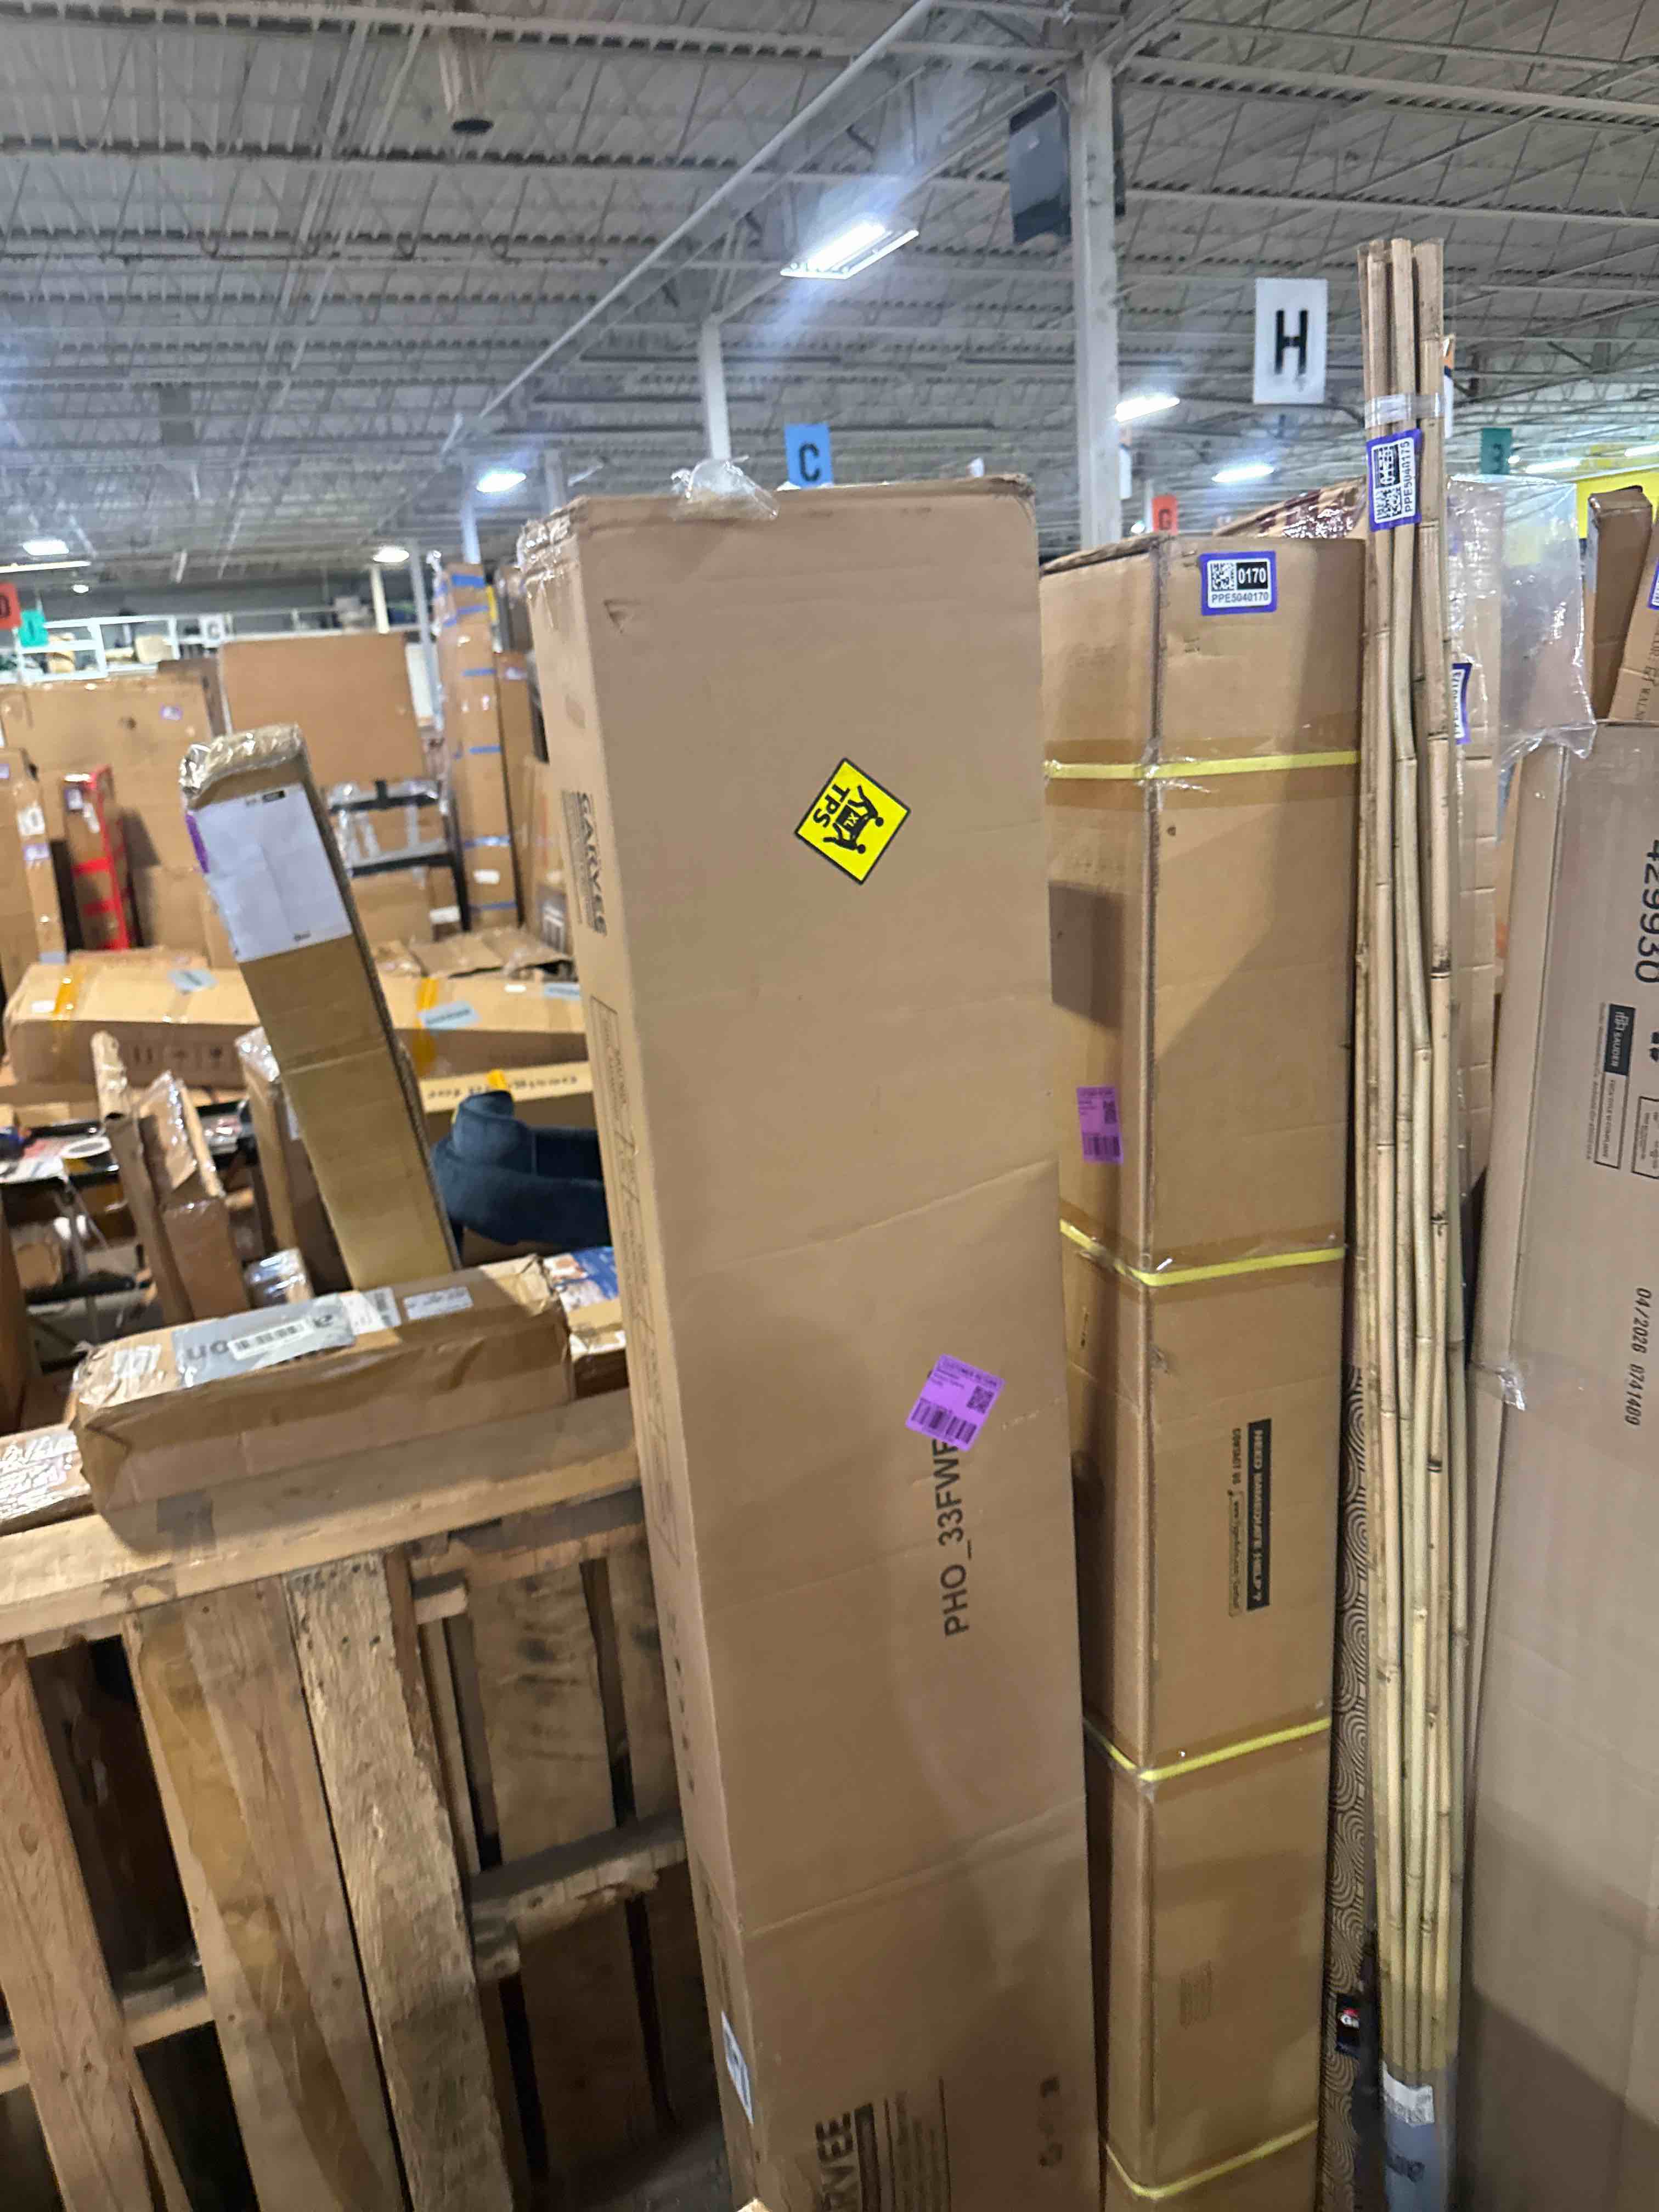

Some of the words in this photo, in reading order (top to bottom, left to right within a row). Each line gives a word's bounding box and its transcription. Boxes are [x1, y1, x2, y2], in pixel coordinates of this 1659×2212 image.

[1275, 309, 1308, 376] H
[798, 442, 821, 483] C
[1238, 567, 1267, 585] 0170
[1211, 591, 1269, 604] PPE5040170
[813, 783, 851, 828] TPS
[843, 812, 861, 828] XL
[1635, 839, 1659, 983] 429930
[1611, 1032, 1622, 1068] SAUDER
